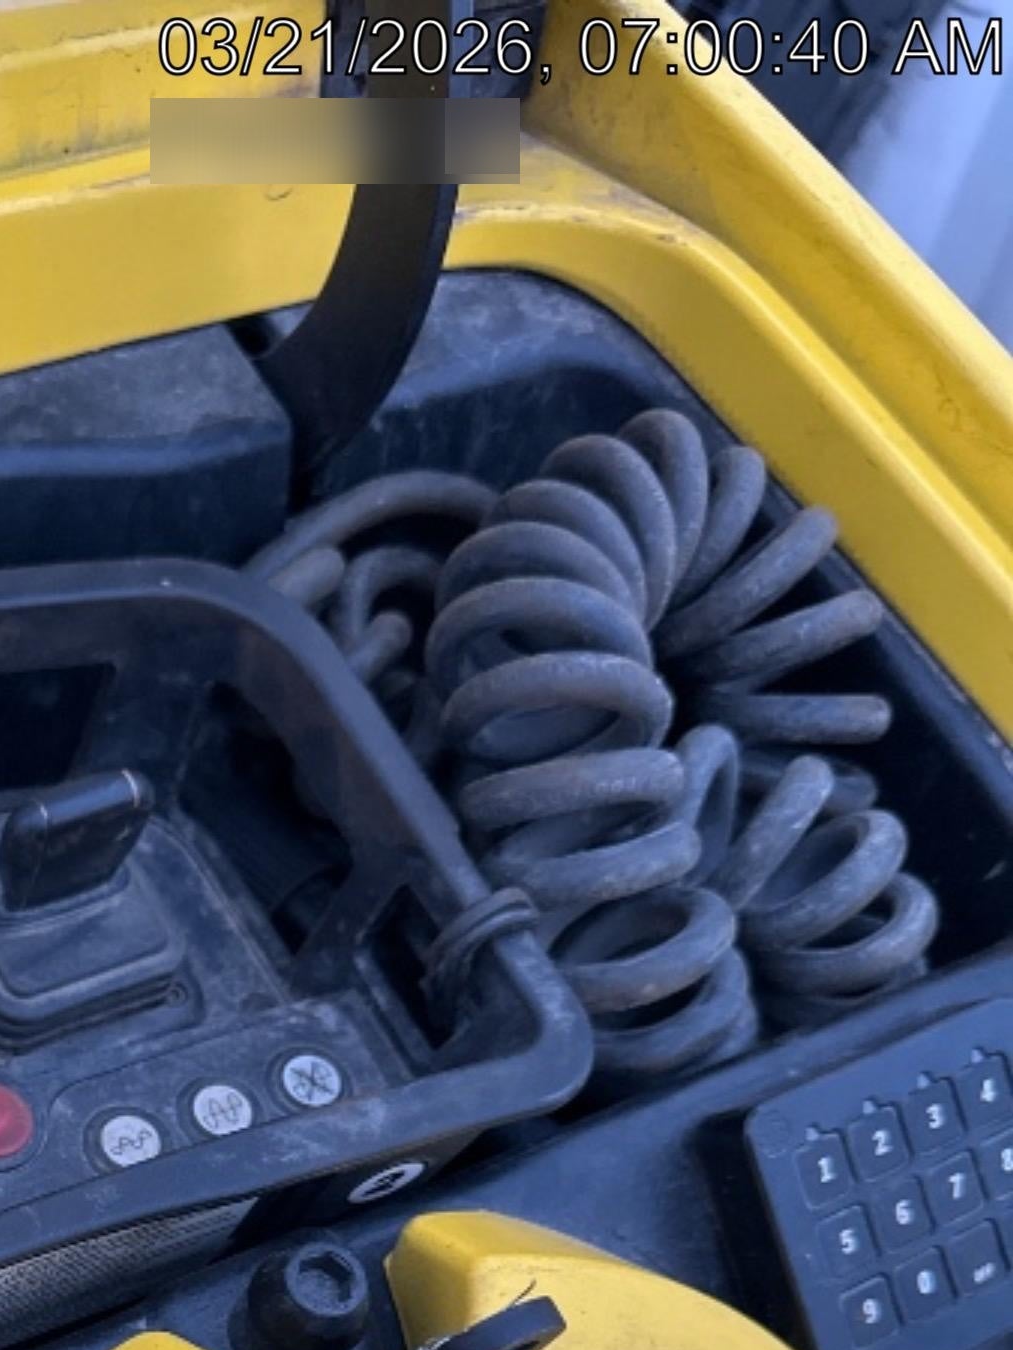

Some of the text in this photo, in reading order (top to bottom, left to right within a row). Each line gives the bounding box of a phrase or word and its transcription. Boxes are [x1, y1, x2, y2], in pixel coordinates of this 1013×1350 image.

[817, 1078, 997, 1184] 1 2 3 4
[839, 1228, 858, 1255] 5
[895, 1199, 914, 1226] 6
[862, 1298, 881, 1325] 9
